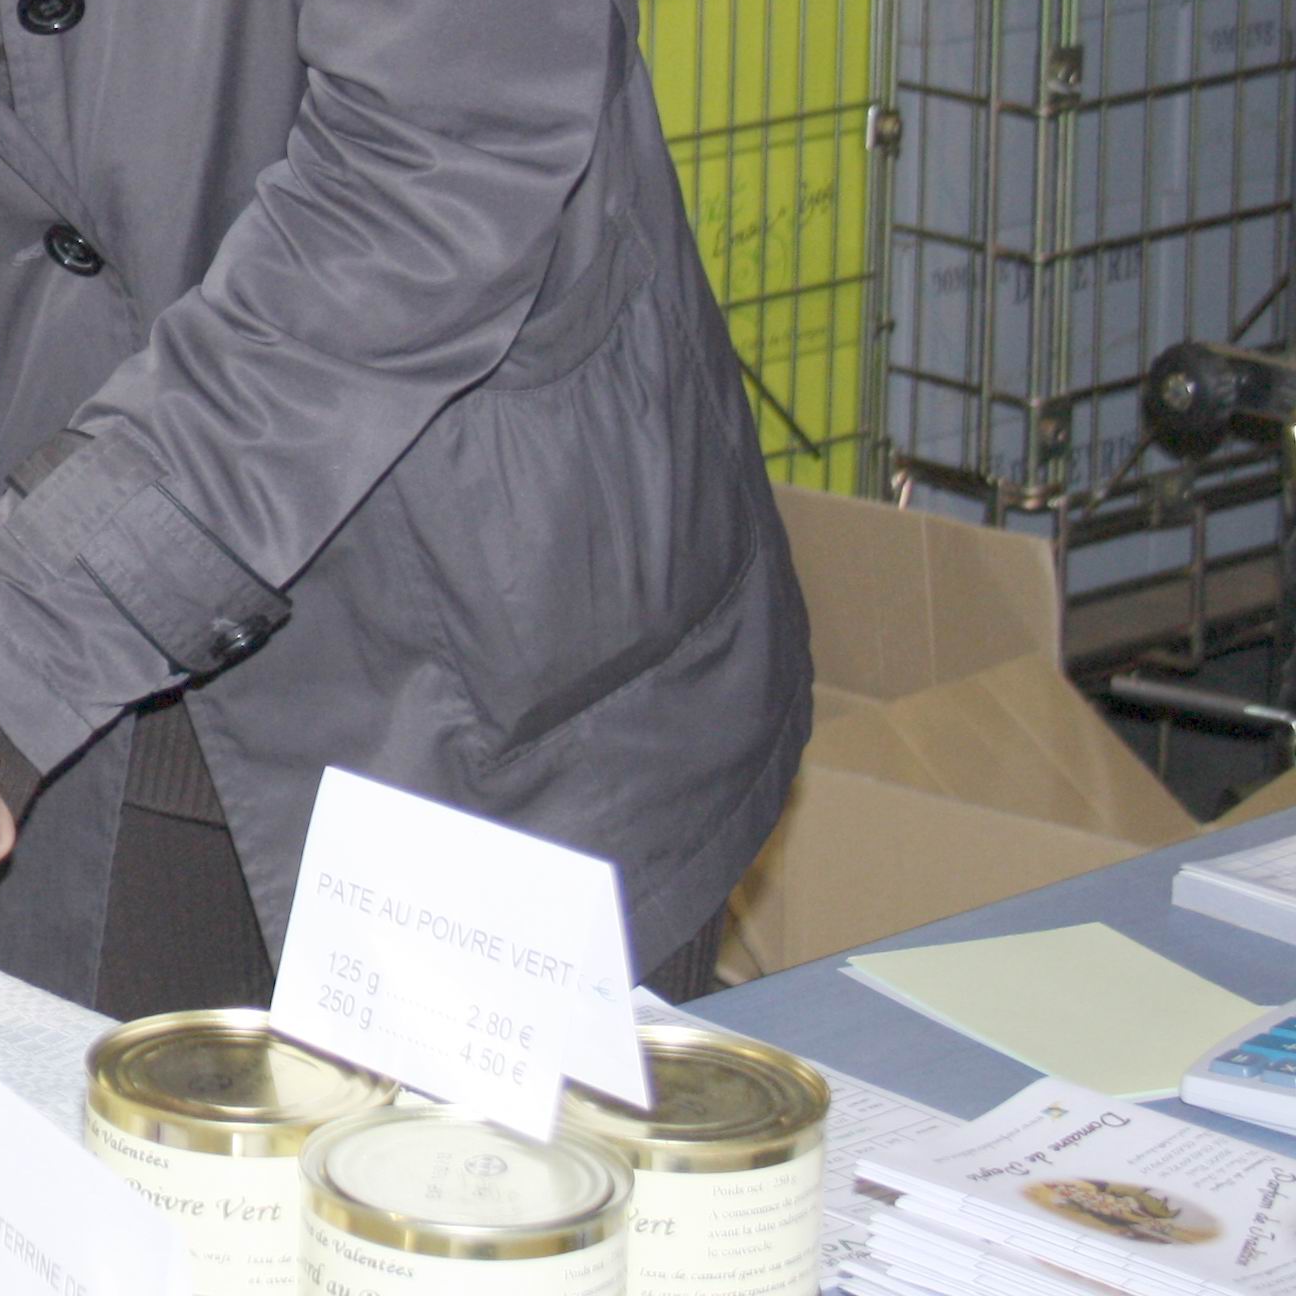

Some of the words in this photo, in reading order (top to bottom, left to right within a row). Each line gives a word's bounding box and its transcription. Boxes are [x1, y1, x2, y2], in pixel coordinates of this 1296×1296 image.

[317, 871, 375, 917] PATE
[376, 897, 411, 929] AU
[416, 907, 504, 962] POIVRE
[509, 940, 575, 991] VERT
[318, 983, 355, 1021] 250
[357, 1002, 374, 1030] g
[459, 1040, 507, 1078] 4.50
[510, 1059, 529, 1087] €
[327, 948, 364, 984] 125
[366, 964, 382, 996] g
[465, 1004, 514, 1043] 2.80
[517, 1024, 536, 1052] €
[102, 1128, 170, 1170] Valentées
